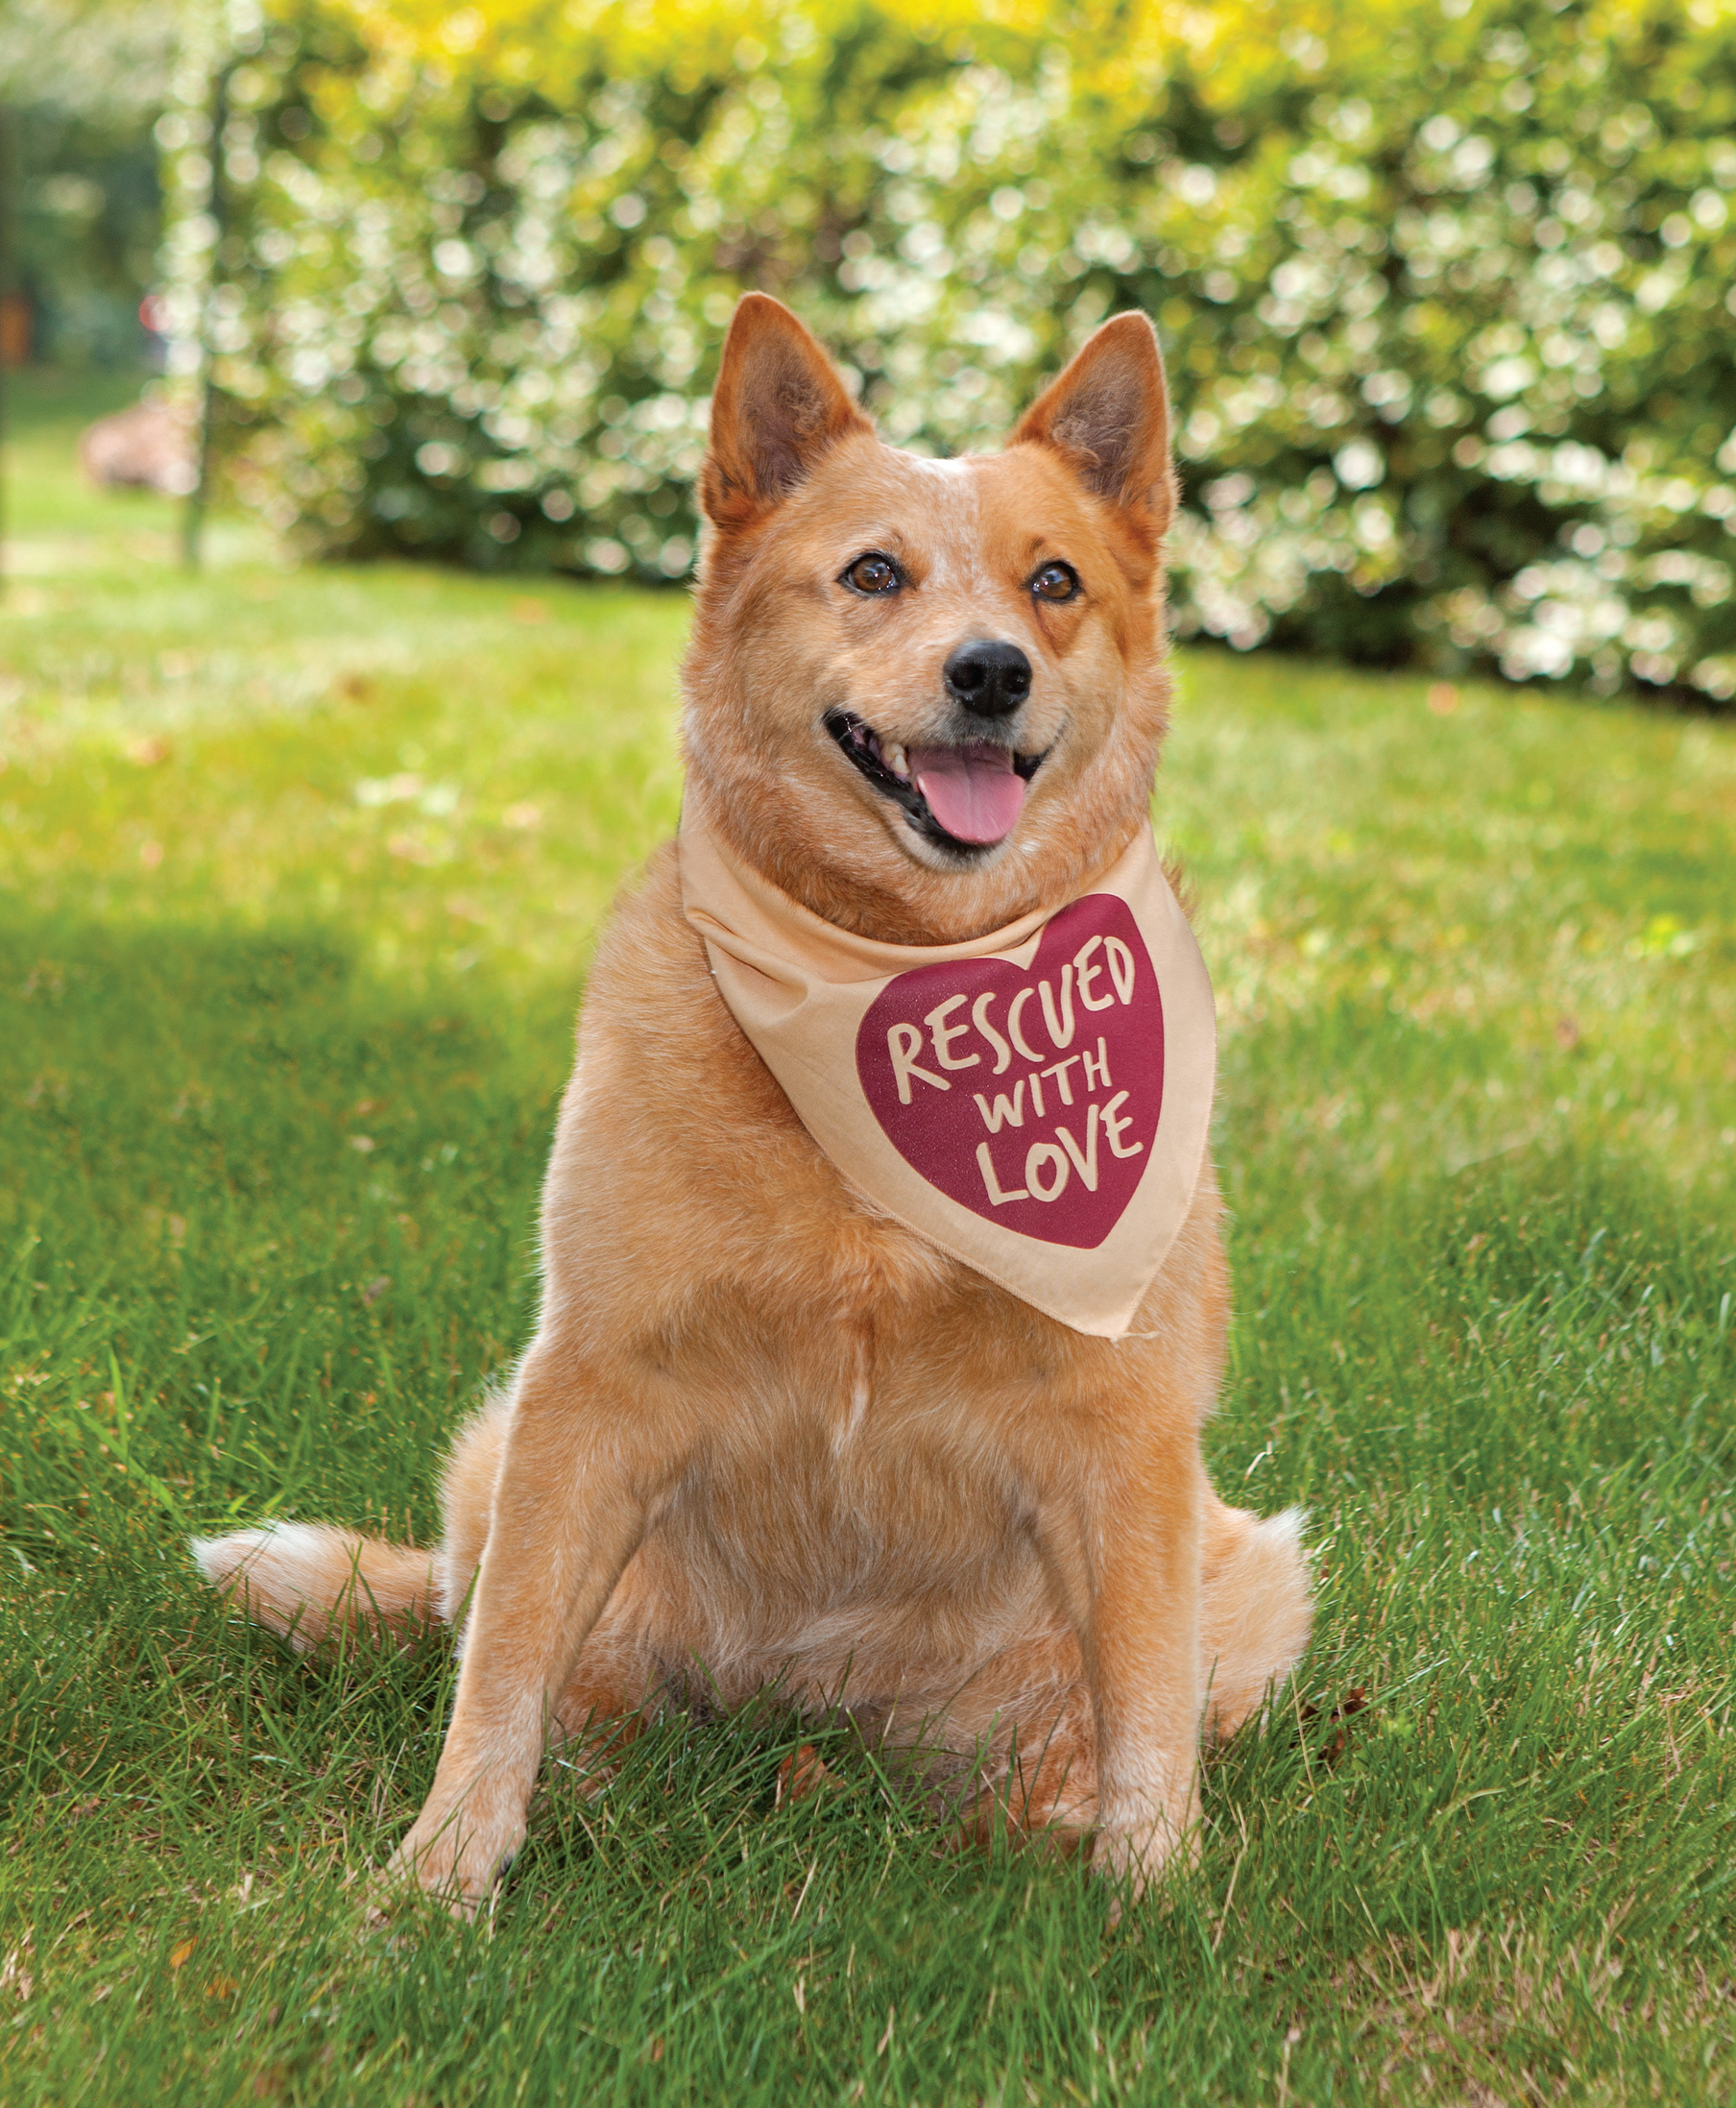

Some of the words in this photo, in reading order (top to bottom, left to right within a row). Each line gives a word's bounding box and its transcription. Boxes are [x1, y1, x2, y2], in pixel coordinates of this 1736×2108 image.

[886, 934, 1136, 1105] RESCUED
[973, 1036, 1113, 1134] WITH
[975, 1090, 1145, 1206] LOVE
